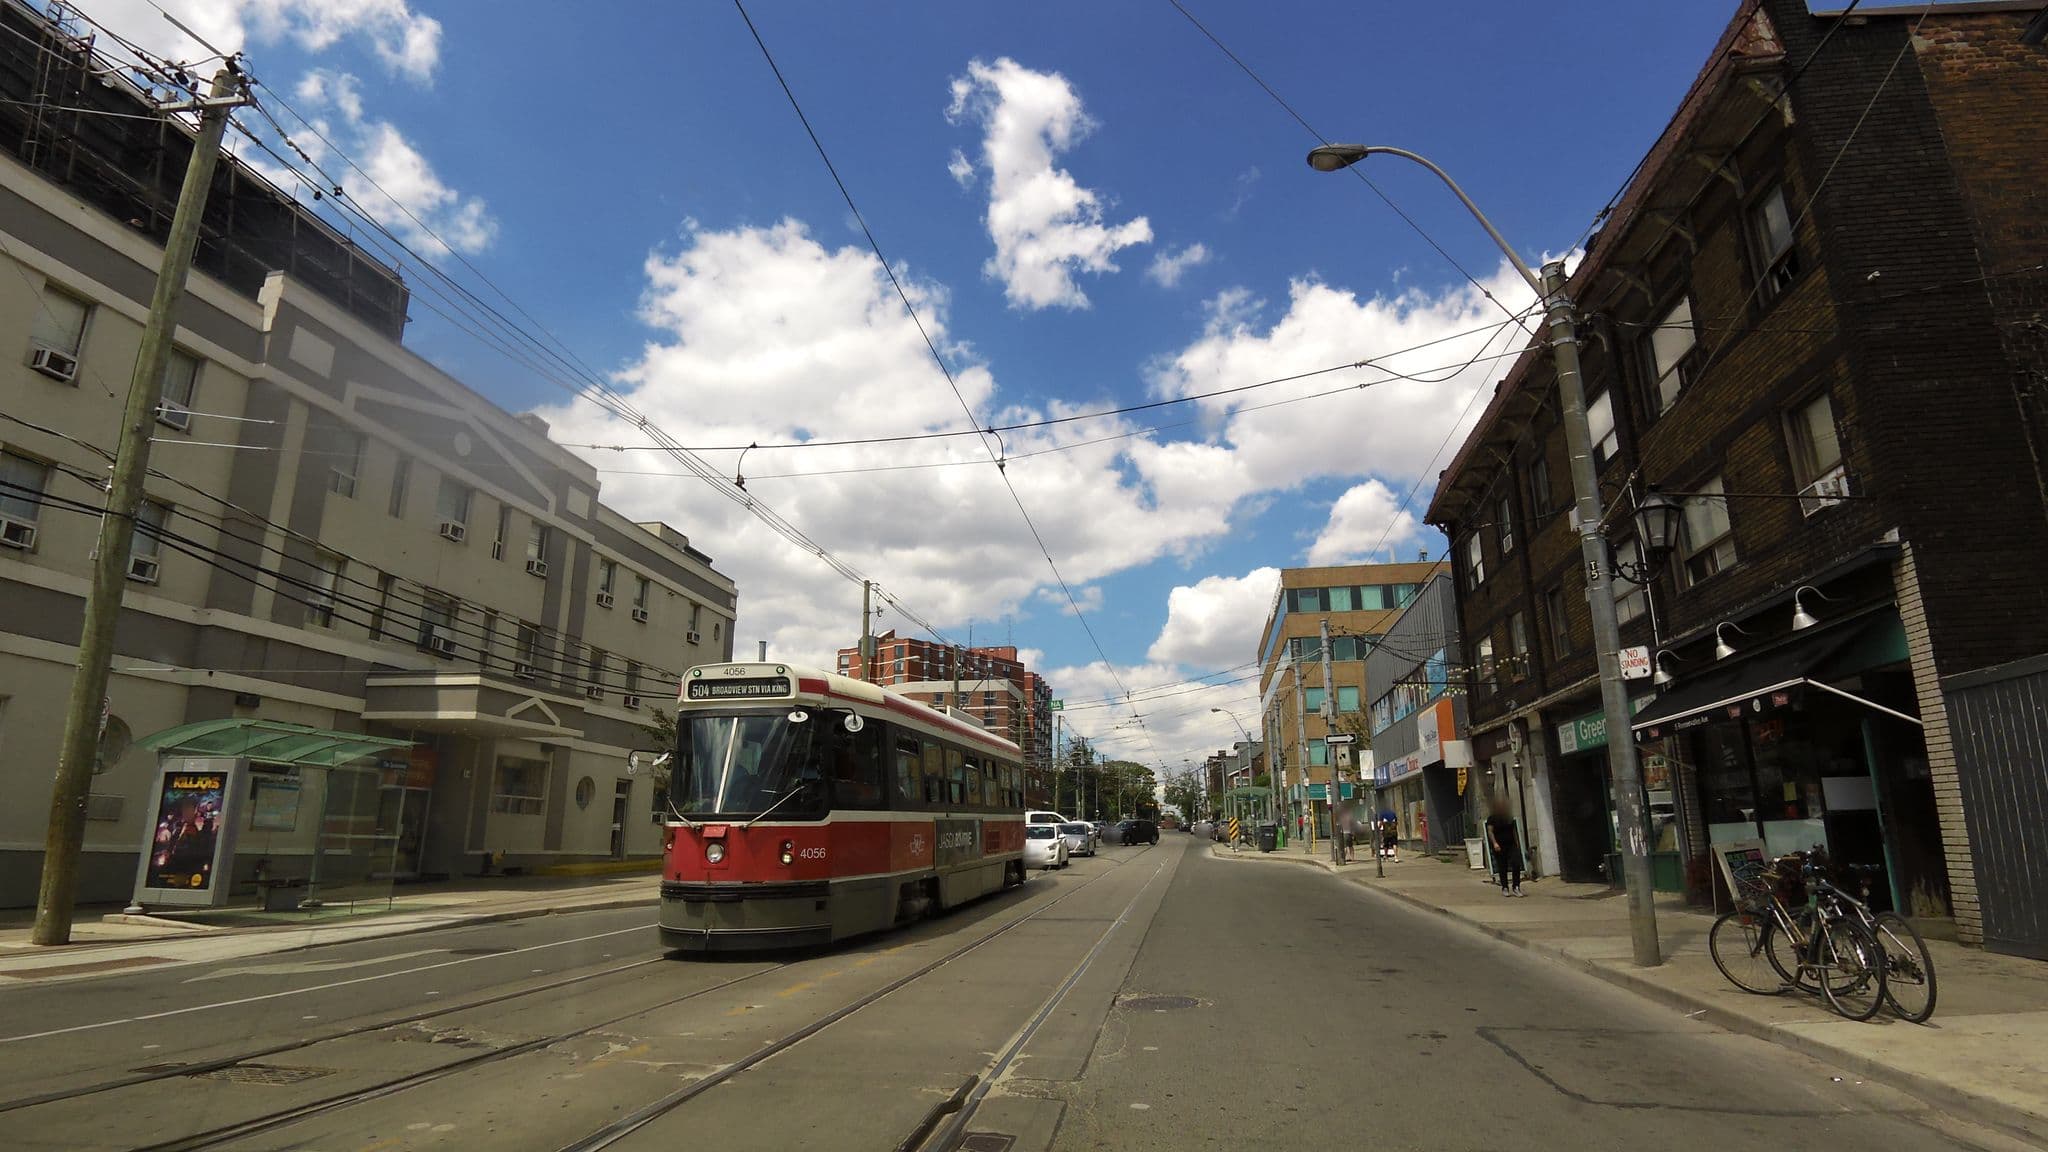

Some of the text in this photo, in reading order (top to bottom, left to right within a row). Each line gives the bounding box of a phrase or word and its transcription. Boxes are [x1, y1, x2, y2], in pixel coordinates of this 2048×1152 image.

[1624, 648, 1639, 659] NO
[1620, 656, 1649, 669] STANDING
[723, 667, 746, 676] 4056
[692, 683, 787, 697] 504 BROADVIEW STN VIA KING
[173, 777, 220, 789] KILLJOYS
[800, 847, 826, 859] 4056
